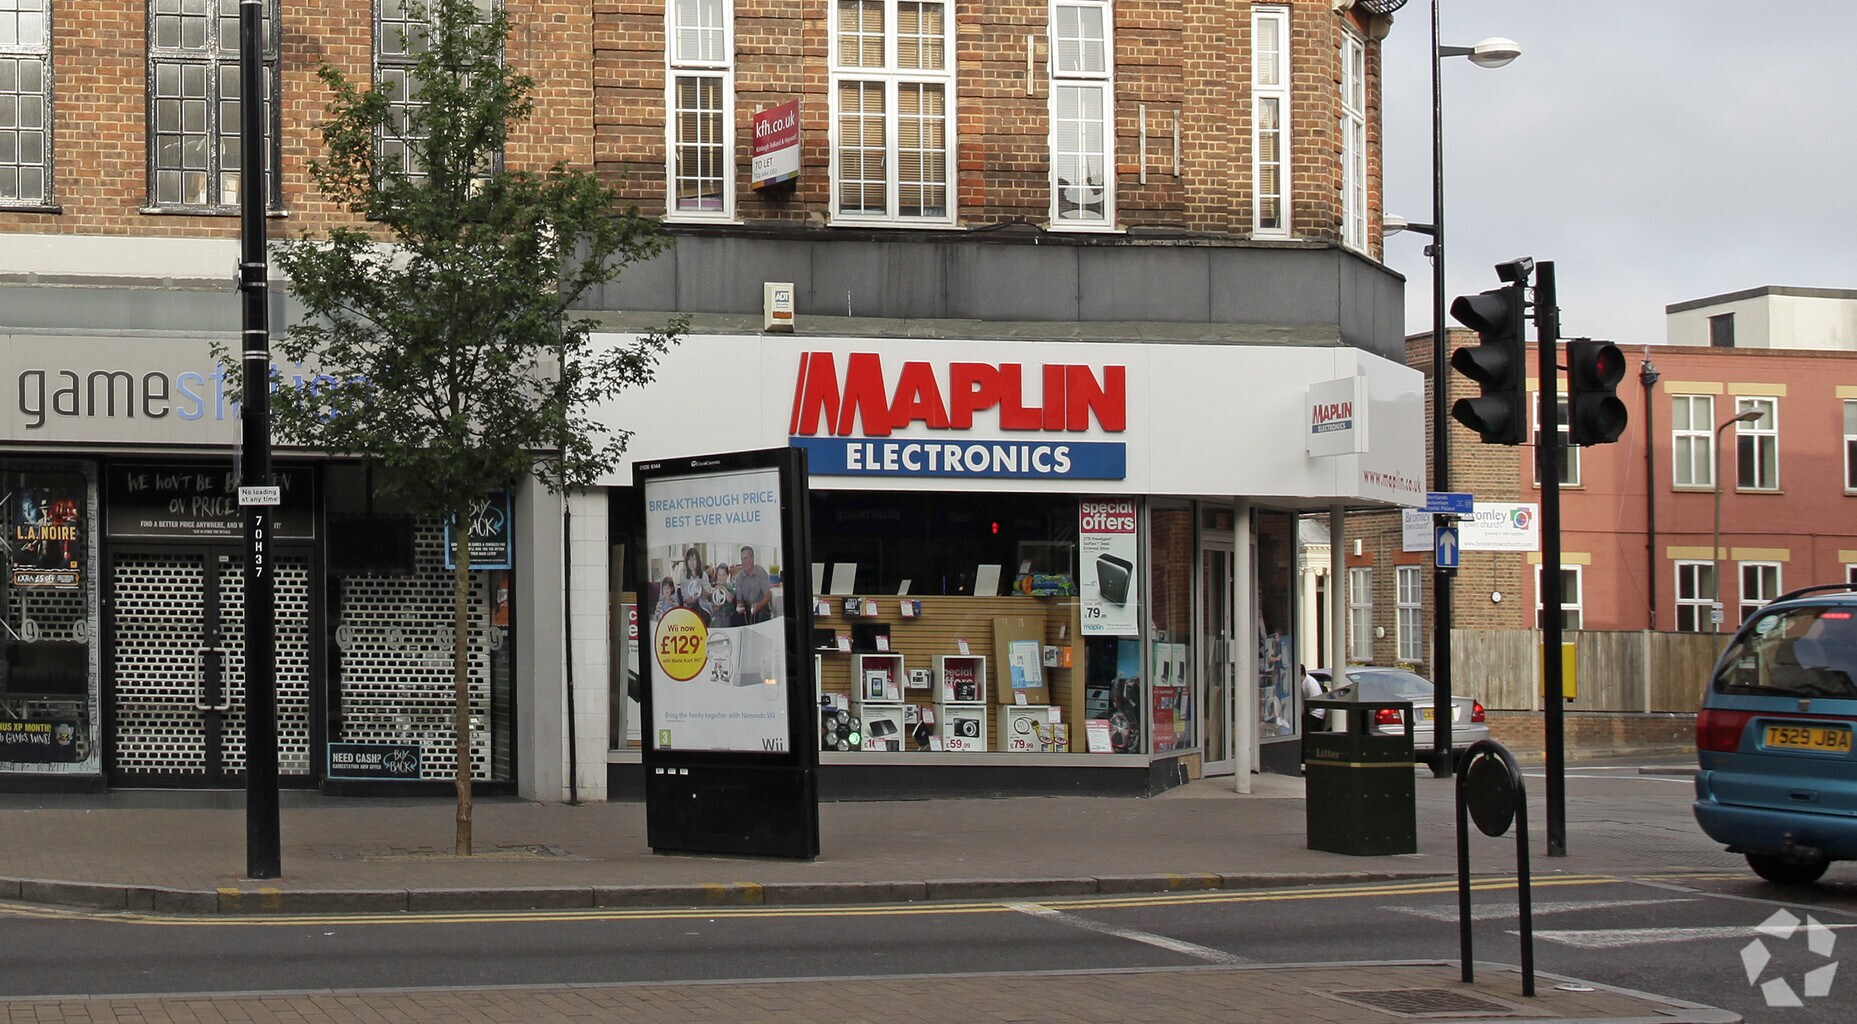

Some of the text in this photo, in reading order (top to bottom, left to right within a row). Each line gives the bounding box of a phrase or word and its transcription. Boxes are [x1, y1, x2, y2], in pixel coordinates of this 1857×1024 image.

[756, 110, 795, 138] kfh.co.uk
[755, 156, 774, 170] TO LET
[775, 290, 790, 302] ADT
[789, 352, 1126, 437] MAPLIN
[1312, 401, 1352, 424] MAPLIN
[1317, 422, 1346, 433] ELECTRONICS
[846, 442, 1071, 473] ELECTRONICS
[196, 475, 213, 491] BE
[1363, 470, 1422, 494] www.maplin.co.uk
[649, 490, 777, 512] BREAKTHROUGH PRICE,
[1082, 501, 1133, 517] special
[665, 510, 761, 528] BEST EVER VALUE
[1082, 513, 1135, 530] offers
[1405, 512, 1430, 525] Bromley
[17, 525, 76, 540] L.A. NOIRE
[467, 517, 497, 537] ACK
[944, 666, 972, 677] pecial
[704, 712, 727, 720] together
[14, 723, 23, 731] XP
[25, 724, 52, 732] MONTH!
[662, 732, 669, 744] 3
[946, 739, 970, 748] £59.99
[1011, 739, 1033, 748] £79.99
[1769, 727, 1848, 747] T529 JBA
[761, 738, 784, 752] Wii
[333, 753, 381, 763] NEED CASH?
[1316, 749, 1340, 759] Litter
[390, 761, 412, 772] BACK
